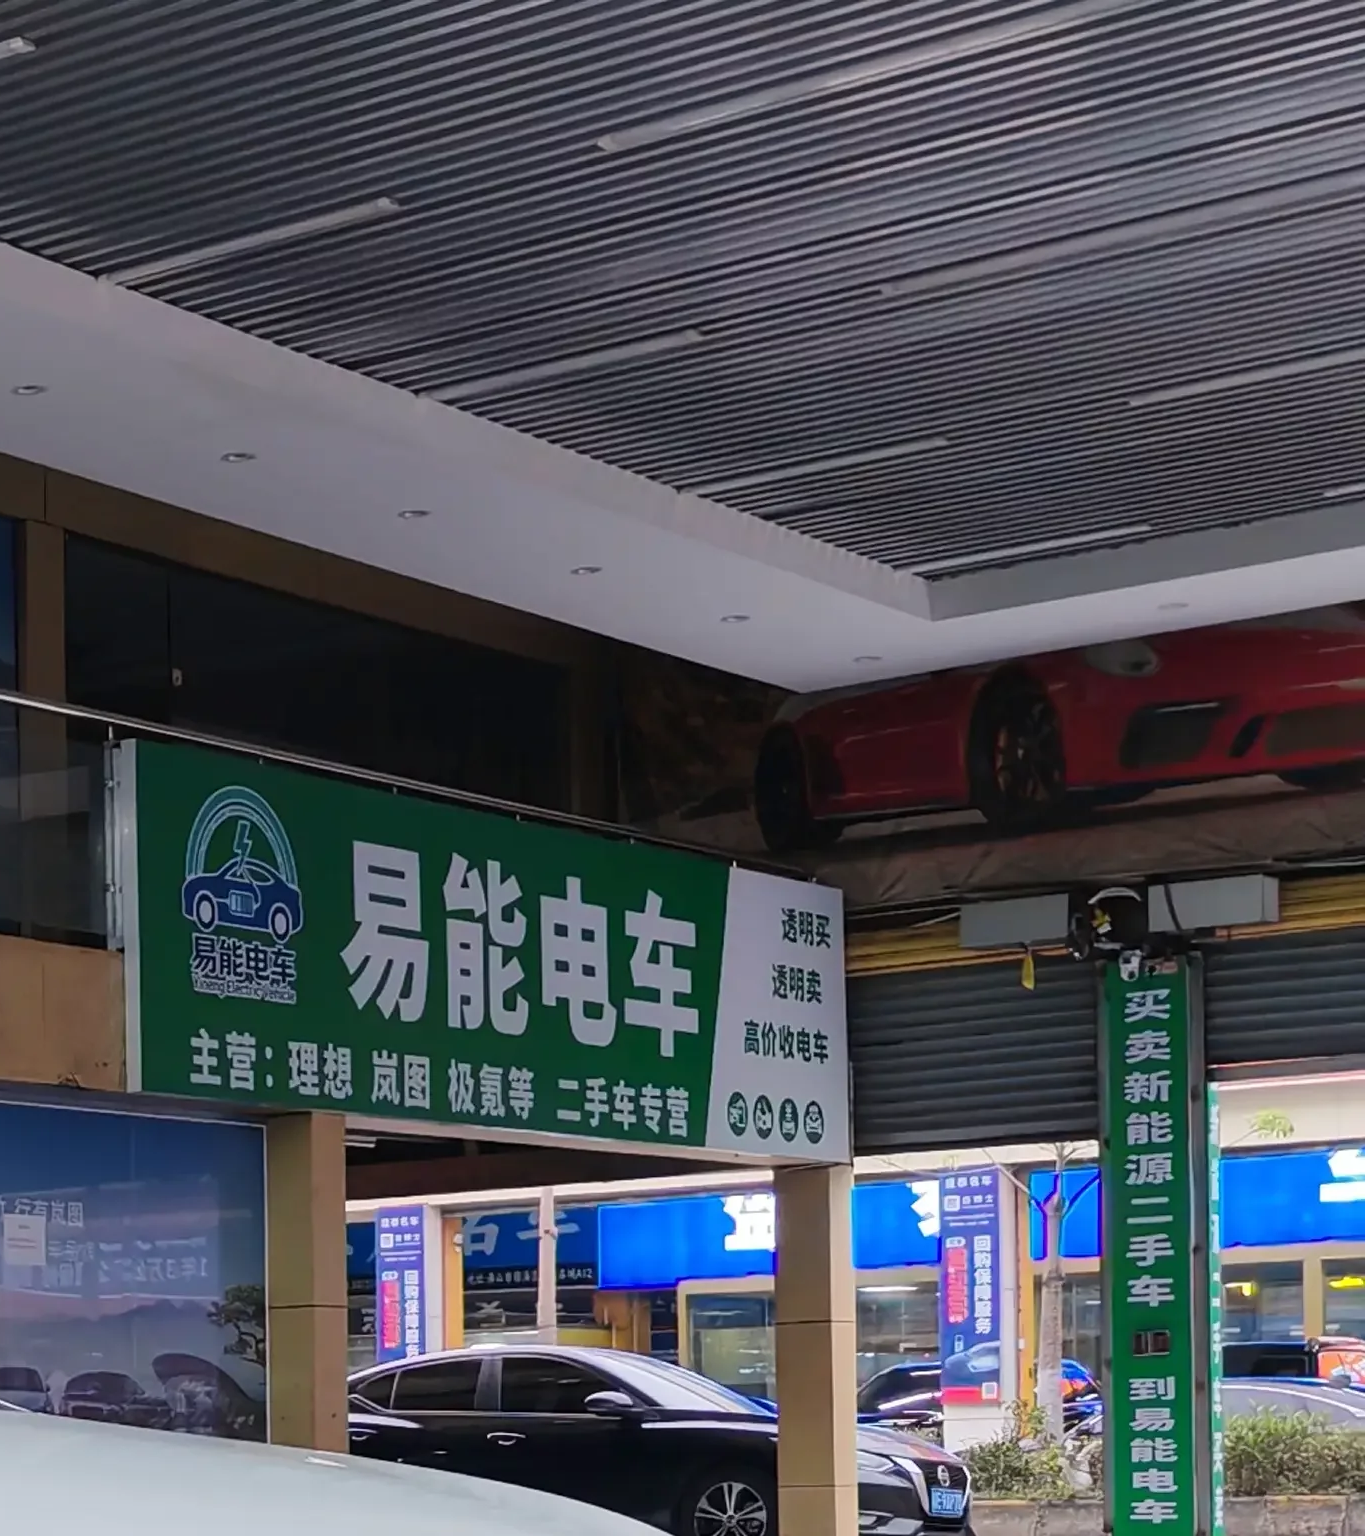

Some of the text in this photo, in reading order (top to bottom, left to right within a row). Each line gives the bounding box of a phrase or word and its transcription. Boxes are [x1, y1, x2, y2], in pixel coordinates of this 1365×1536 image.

[340, 841, 699, 1058] 易能电车
[781, 906, 832, 950] 透明买
[191, 932, 297, 986] 易能电车
[771, 963, 823, 1005] 透明卖
[744, 1020, 830, 1065] 高价收电车
[371, 1049, 432, 1111] 岚图
[447, 1058, 535, 1120] 极氪等
[555, 1078, 689, 1138] 二手车专营
[1124, 989, 1178, 1524] 买卖新能源二手车 到易能电车
